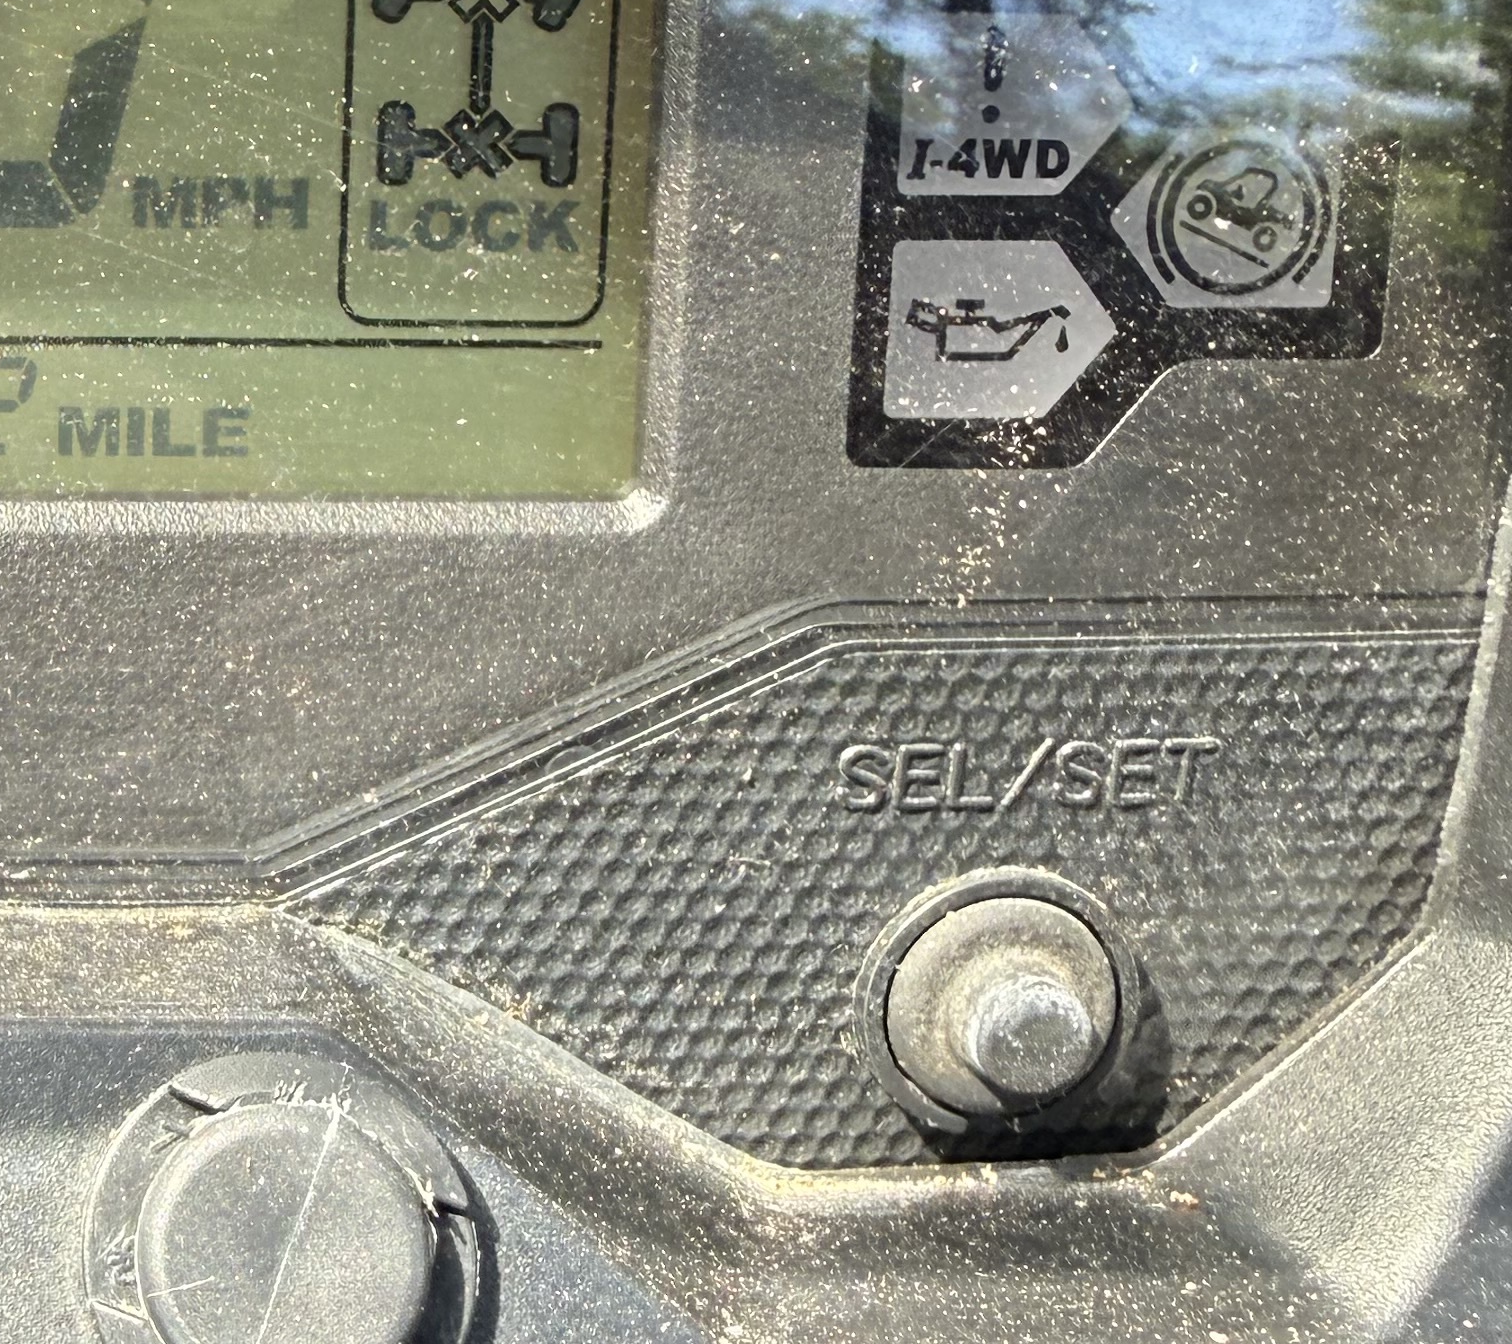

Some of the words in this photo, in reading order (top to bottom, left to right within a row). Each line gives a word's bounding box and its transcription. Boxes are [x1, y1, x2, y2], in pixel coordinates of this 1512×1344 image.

[905, 137, 1072, 182] I-4WD
[131, 174, 310, 230] MPH
[368, 198, 581, 254] LOCK
[56, 406, 252, 457] MILE
[838, 736, 1224, 814] SEL/SET
